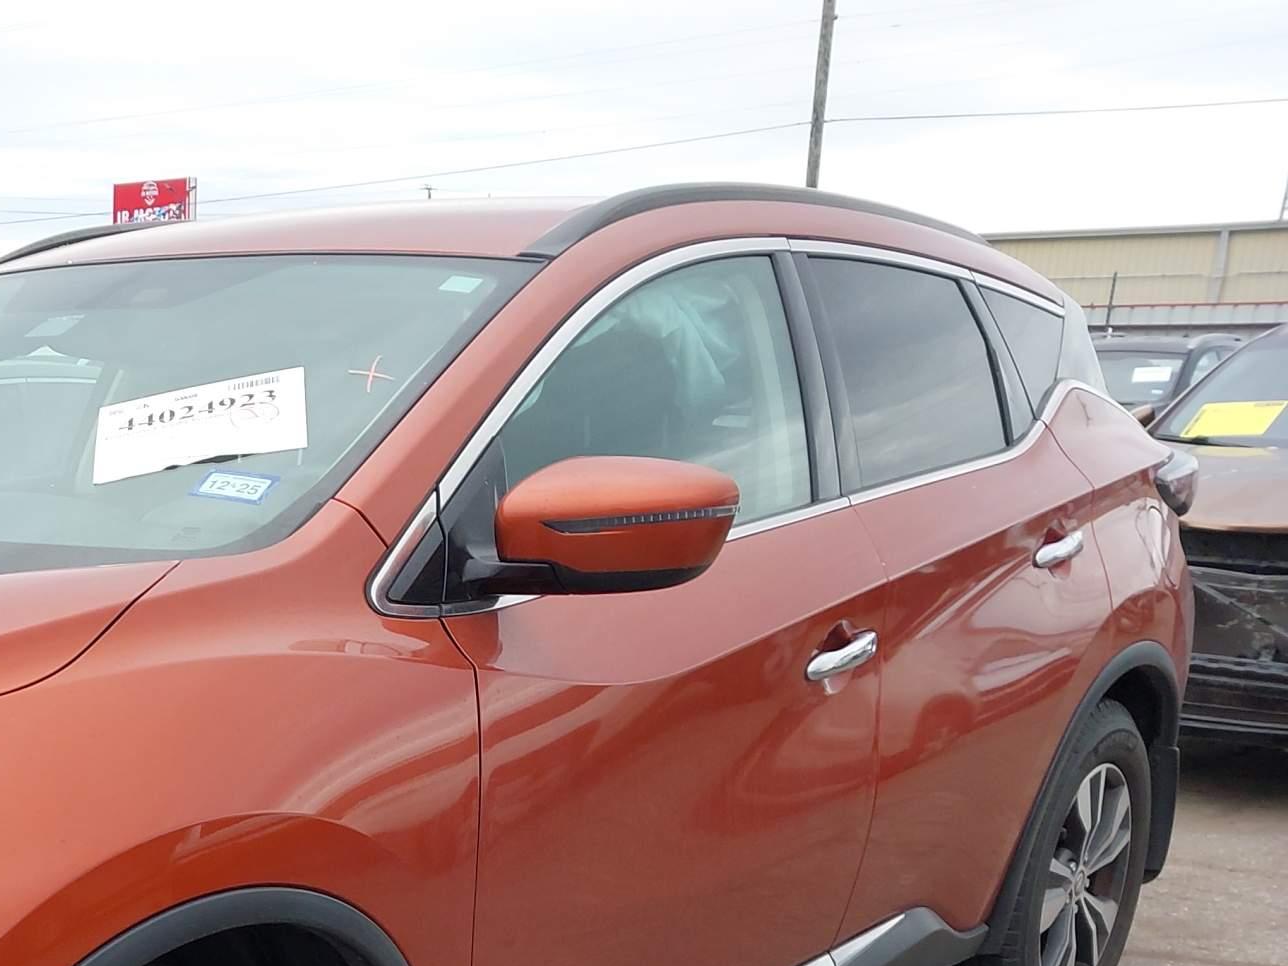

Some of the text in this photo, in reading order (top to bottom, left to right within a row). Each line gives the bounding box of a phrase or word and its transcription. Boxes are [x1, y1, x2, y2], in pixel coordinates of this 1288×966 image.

[118, 389, 277, 431] 44024923
[209, 479, 261, 495] 12 25
